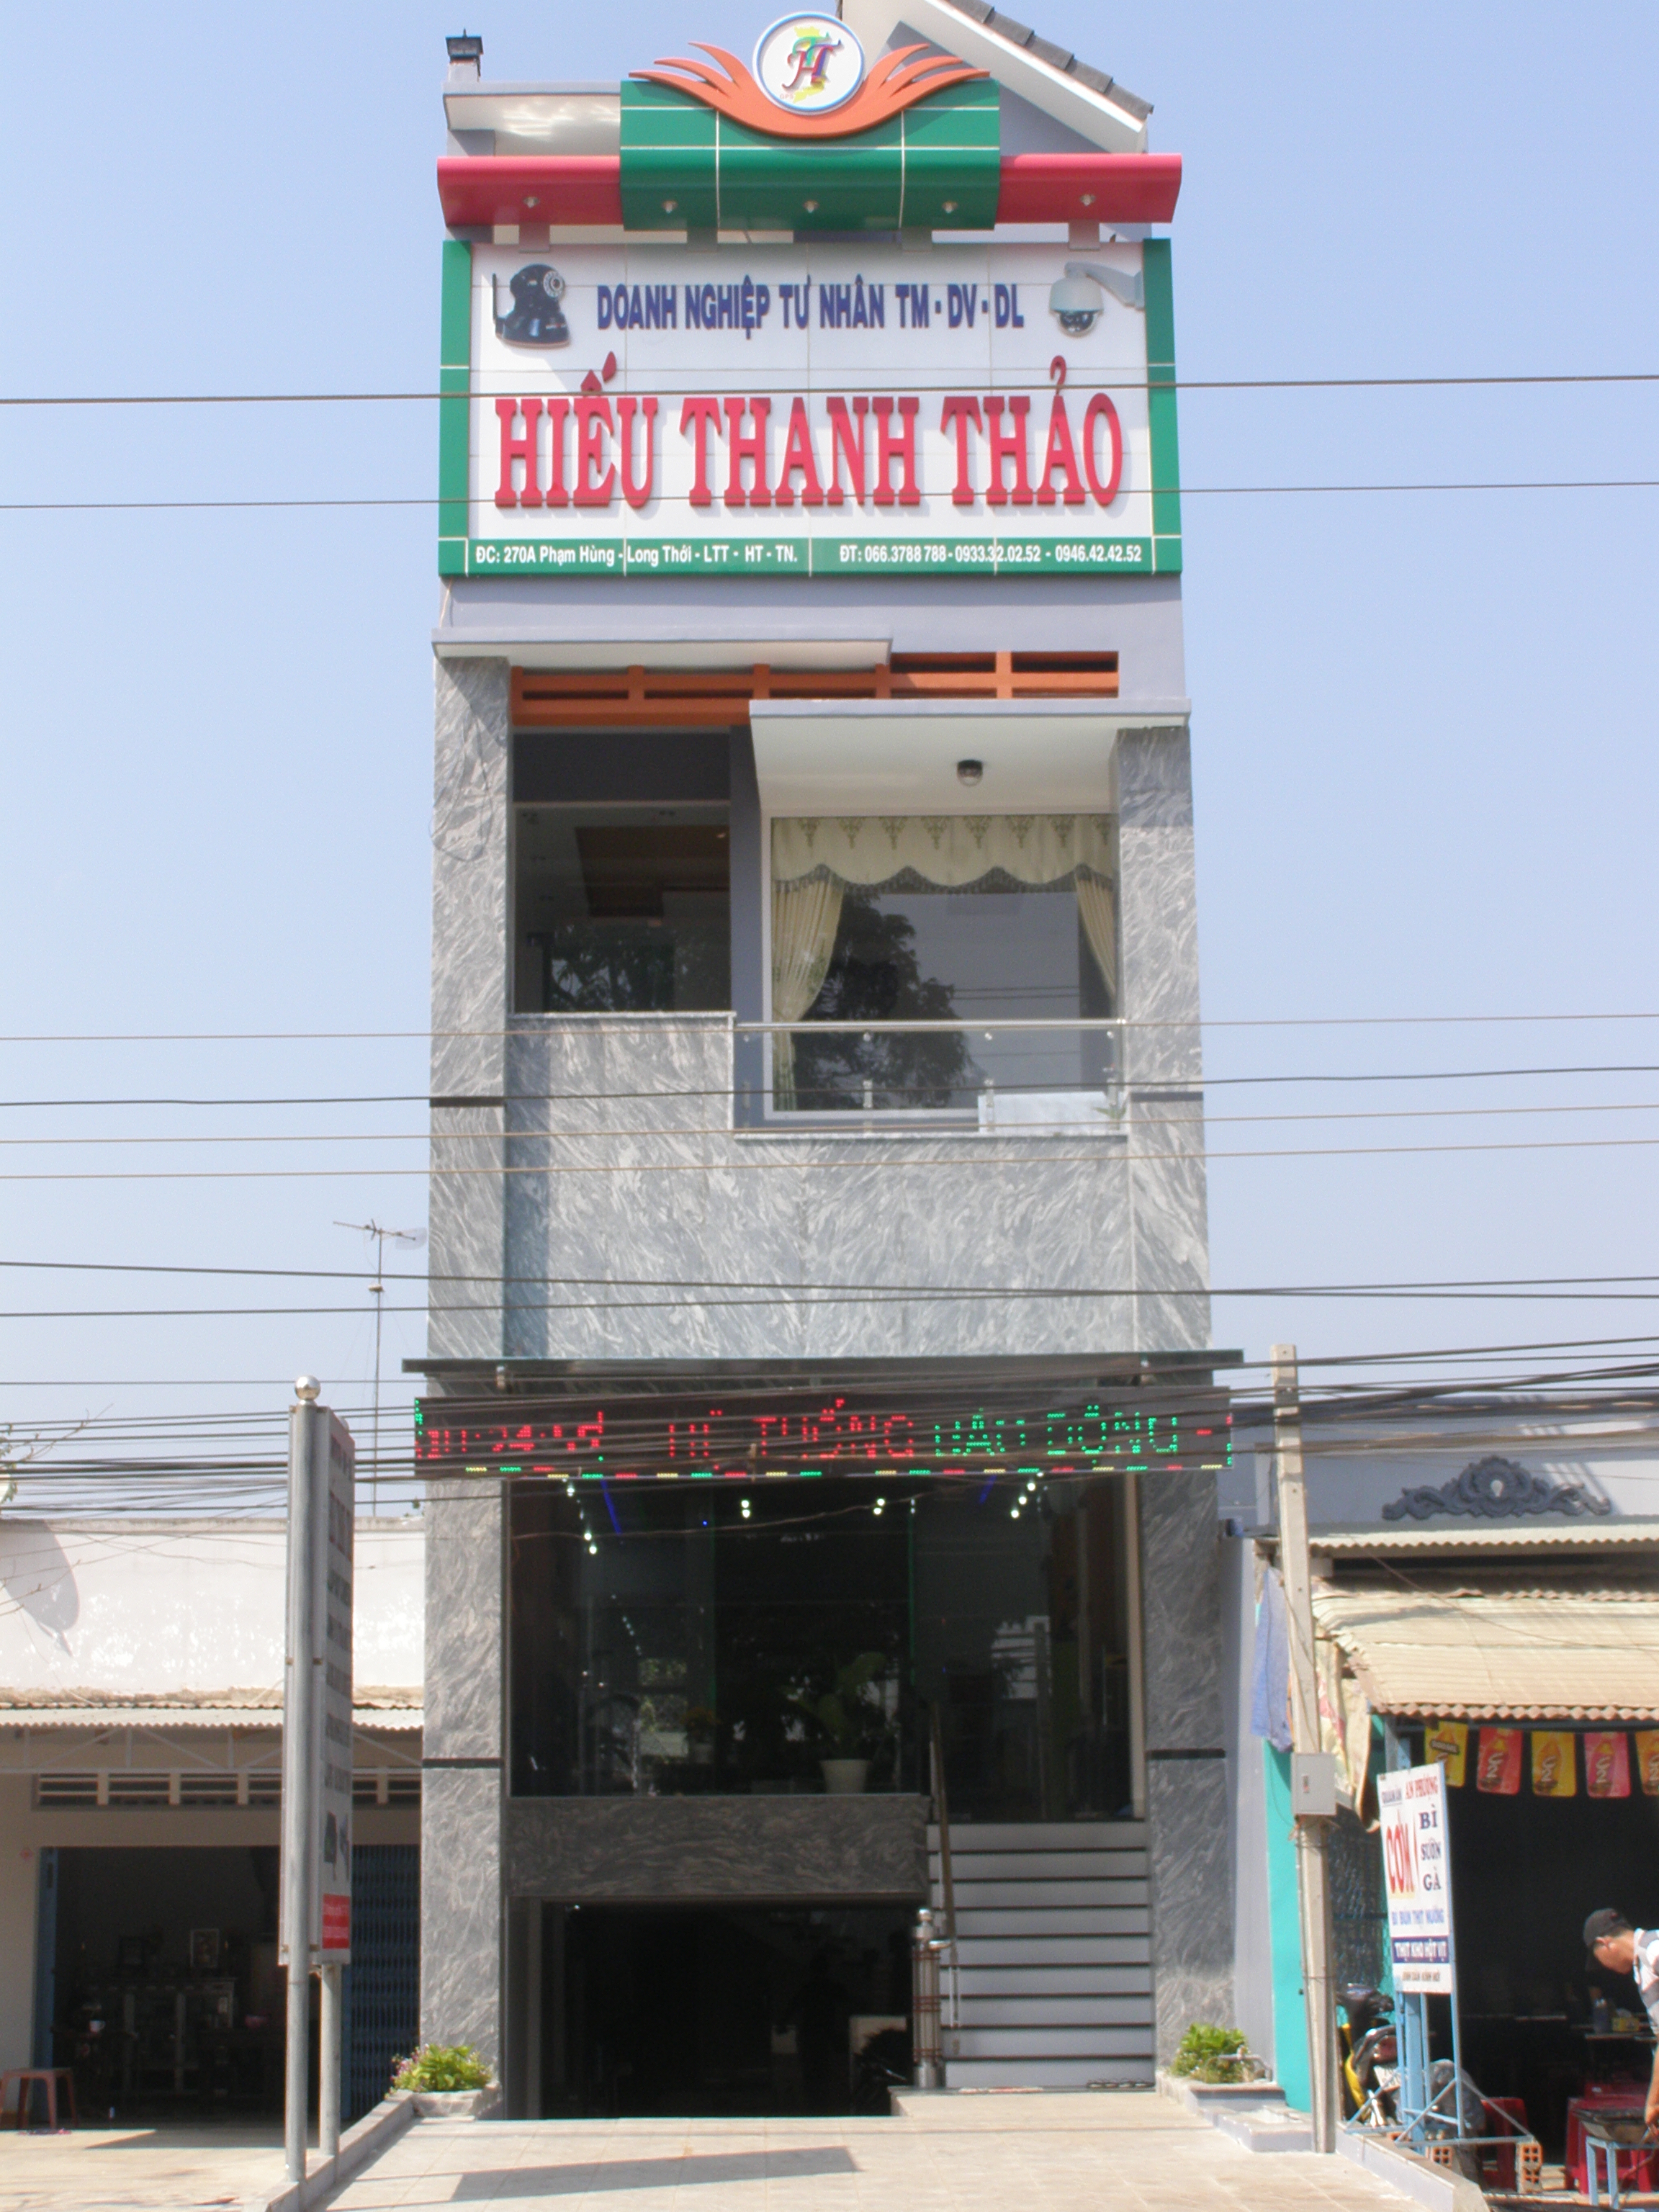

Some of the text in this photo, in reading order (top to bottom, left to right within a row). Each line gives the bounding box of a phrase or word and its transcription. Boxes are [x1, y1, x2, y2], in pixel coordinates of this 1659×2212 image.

[597, 283, 676, 328] DOANH
[684, 274, 770, 339] NGHIỆP
[778, 274, 811, 328] TƯ
[819, 273, 885, 325] NHÂN
[895, 282, 930, 325] TM
[947, 282, 977, 326] DV
[994, 282, 1025, 326] DL
[495, 351, 1123, 508] HIẾU THANH THẢO
[475, 545, 500, 563] ĐC:
[504, 545, 536, 563] 270A
[539, 545, 576, 567] Phạm
[580, 545, 615, 567] Hùng
[626, 545, 659, 567] Long
[662, 544, 692, 562] Thới
[703, 544, 729, 562] LTT
[745, 544, 764, 562] HT
[775, 544, 797, 562] TN.
[840, 545, 862, 562] ĐT:
[1055, 544, 1141, 562] 0946.42.42.52
[1419, 1804, 1438, 1830] BÌ
[1423, 1865, 1442, 1892] GÀ
